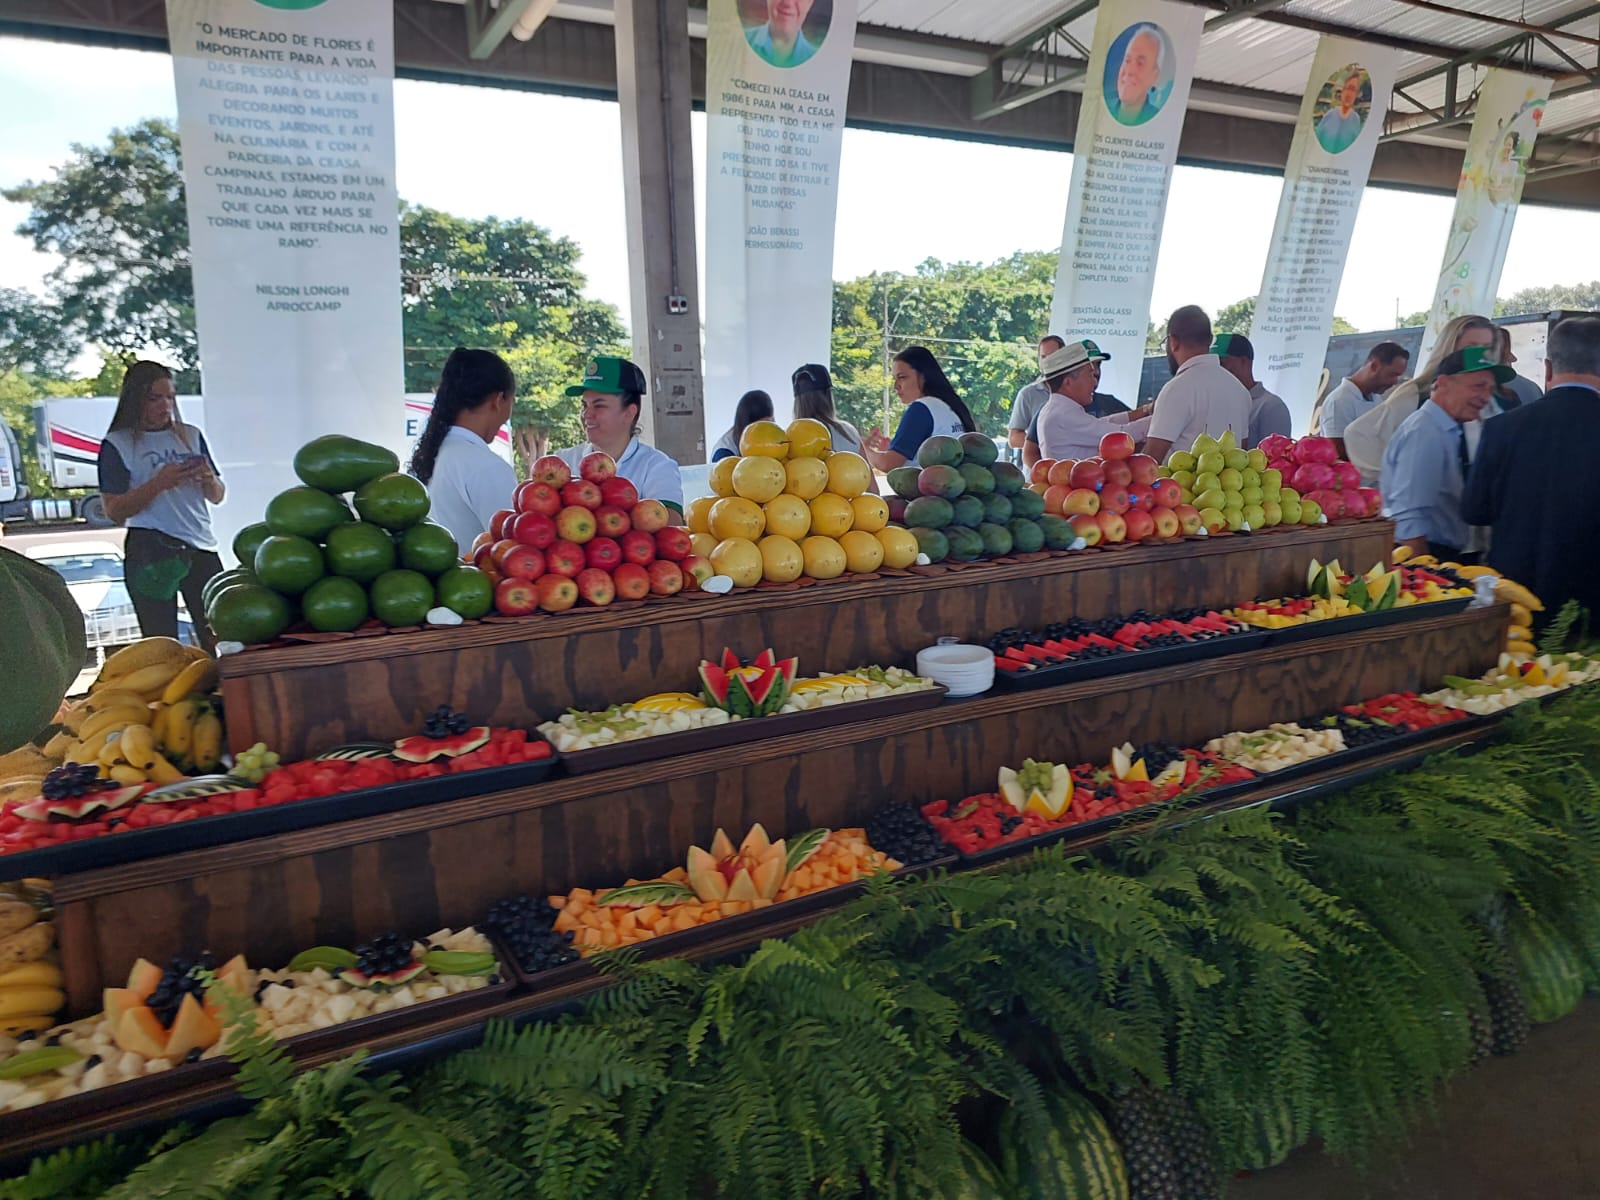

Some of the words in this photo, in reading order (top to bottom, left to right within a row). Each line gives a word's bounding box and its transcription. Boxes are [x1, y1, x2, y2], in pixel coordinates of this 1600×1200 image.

[218, 25, 288, 44] MERCADO
[292, 33, 308, 47] DE
[313, 36, 363, 52] FLORES
[367, 38, 375, 52] É
[196, 40, 285, 62] IMPORTANTE
[289, 52, 324, 66] PARA
[330, 53, 340, 66] A
[346, 55, 376, 69] VIDA
[207, 60, 236, 75] DAS
[306, 70, 369, 86] LEVANDO
[199, 77, 258, 95] ALEGRIA
[263, 85, 299, 98] PARA
[304, 88, 320, 100] OS
[325, 90, 367, 103] LARES
[371, 93, 379, 104] E
[773, 85, 786, 96] NA
[789, 88, 814, 101] CEASA
[817, 92, 830, 103] EM
[224, 98, 306, 116] DECORANDO
[310, 106, 359, 120] MUITOS
[721, 92, 744, 104] 1986
[745, 96, 750, 106] E
[753, 97, 776, 110] PARA
[798, 104, 804, 114] A
[807, 106, 835, 118] CEASA
[720, 107, 775, 124] REPRESENTA
[338, 124, 347, 136] E
[351, 124, 375, 137] ATÉ
[756, 127, 779, 139] TUDO
[788, 131, 804, 143] QUE
[807, 134, 819, 144] EU
[213, 132, 234, 145] NA
[315, 138, 323, 149] E
[328, 140, 357, 153] COM
[361, 142, 371, 153] A
[794, 145, 812, 157] SOU
[228, 151, 292, 167] PARCERIA
[297, 155, 314, 167] DA
[319, 156, 361, 169] CEASA
[811, 161, 830, 173] TIVE
[720, 165, 728, 175] A
[281, 172, 338, 185] ESTAMOS
[342, 175, 361, 186] EM
[365, 176, 386, 187] UM
[216, 183, 287, 199] TRABALHO
[292, 186, 337, 200] ÁRDUO
[341, 191, 376, 202] PARA
[770, 186, 807, 198] DIVERSAS
[221, 201, 249, 214] QUE
[254, 203, 289, 216] CADA
[294, 205, 318, 217] VEZ
[322, 206, 354, 218] MAIS
[358, 208, 373, 219] SE
[207, 216, 252, 230] TORNE
[256, 219, 285, 231] UMA
[289, 218, 365, 235] REFERÊNCIA
[369, 224, 388, 236] NO
[256, 284, 300, 297] NILSON
[303, 285, 350, 297] LONGHI
[266, 301, 342, 312] APROCCAMP
